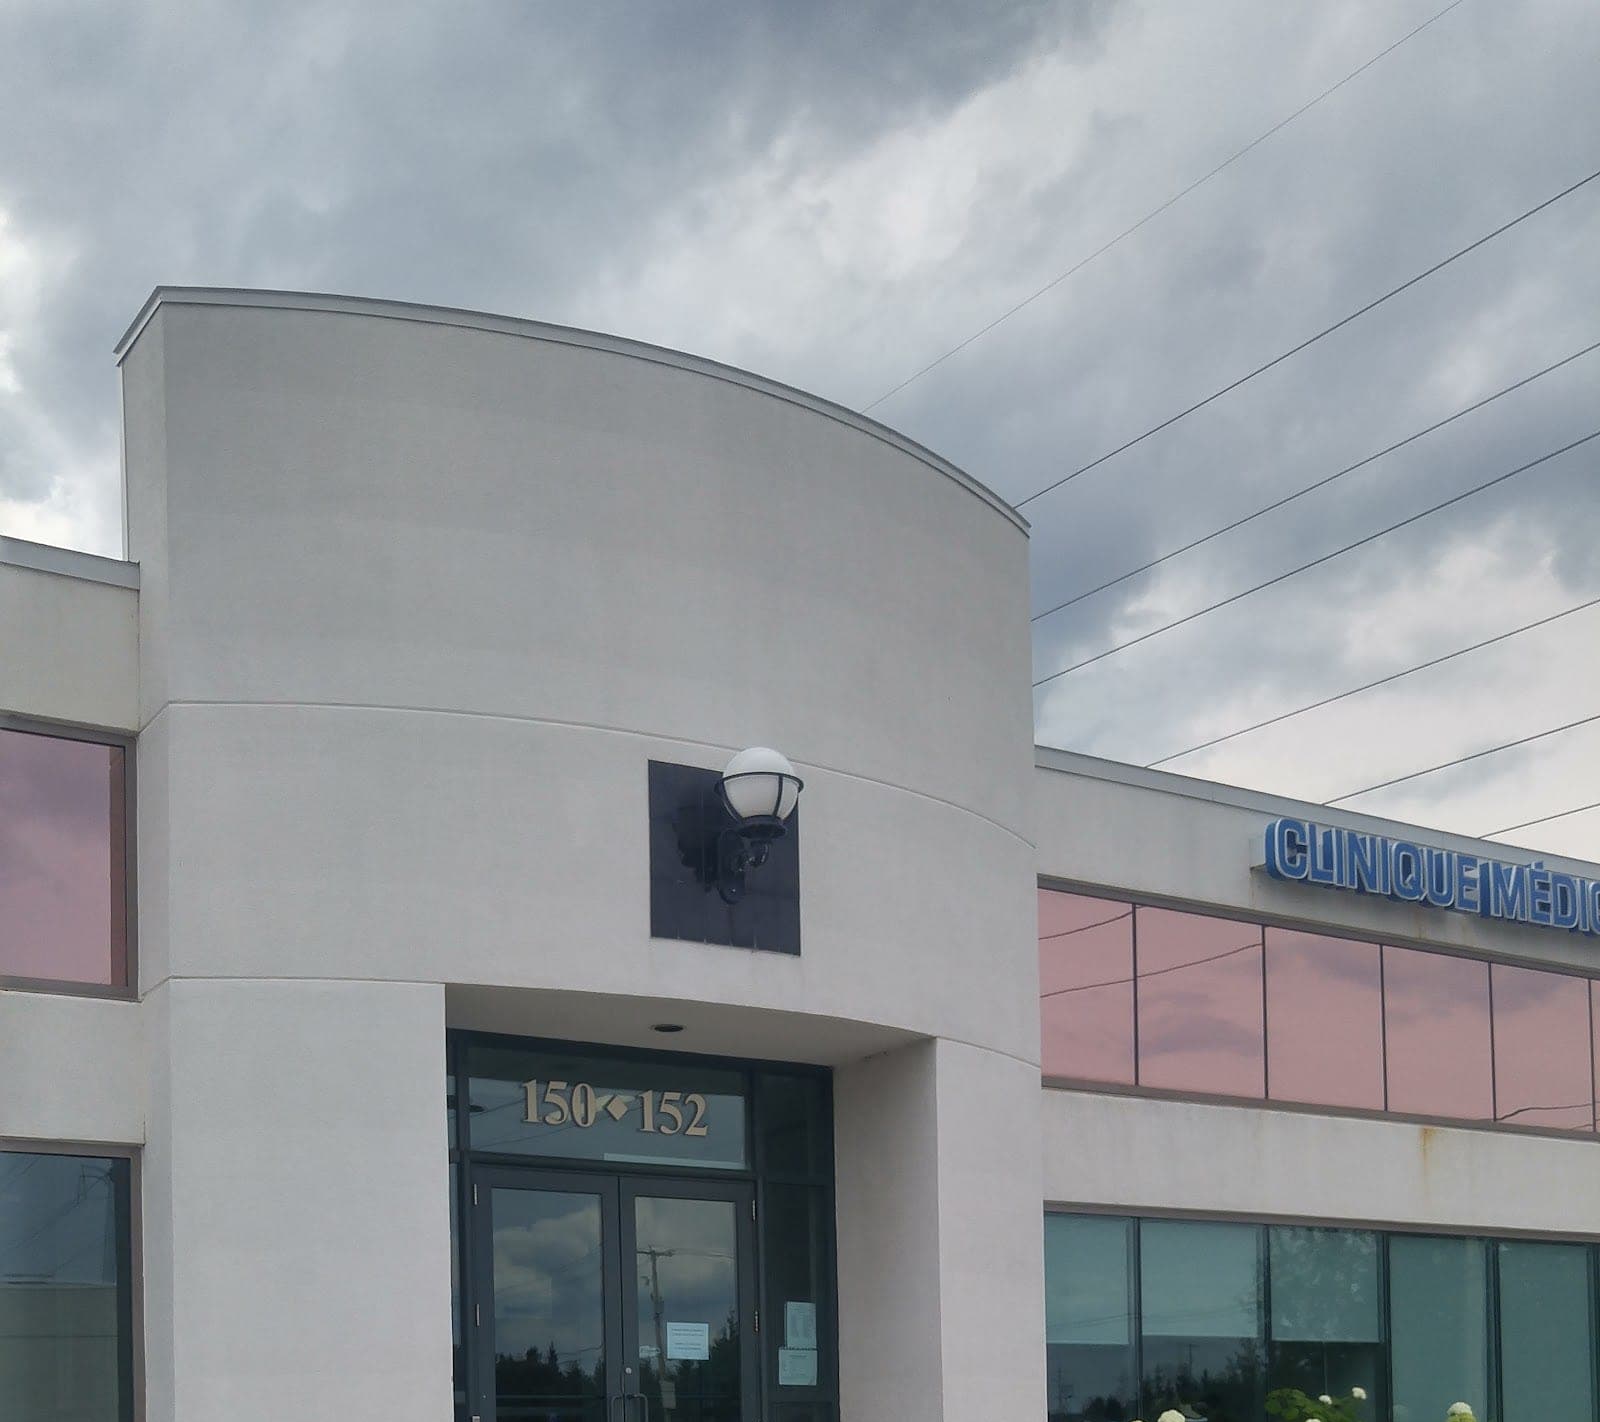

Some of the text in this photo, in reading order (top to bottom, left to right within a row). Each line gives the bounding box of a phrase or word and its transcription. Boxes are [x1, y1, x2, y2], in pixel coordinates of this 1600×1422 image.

[1265, 817, 1481, 914] CLINIQUE
[522, 1078, 709, 1137] 150 152
